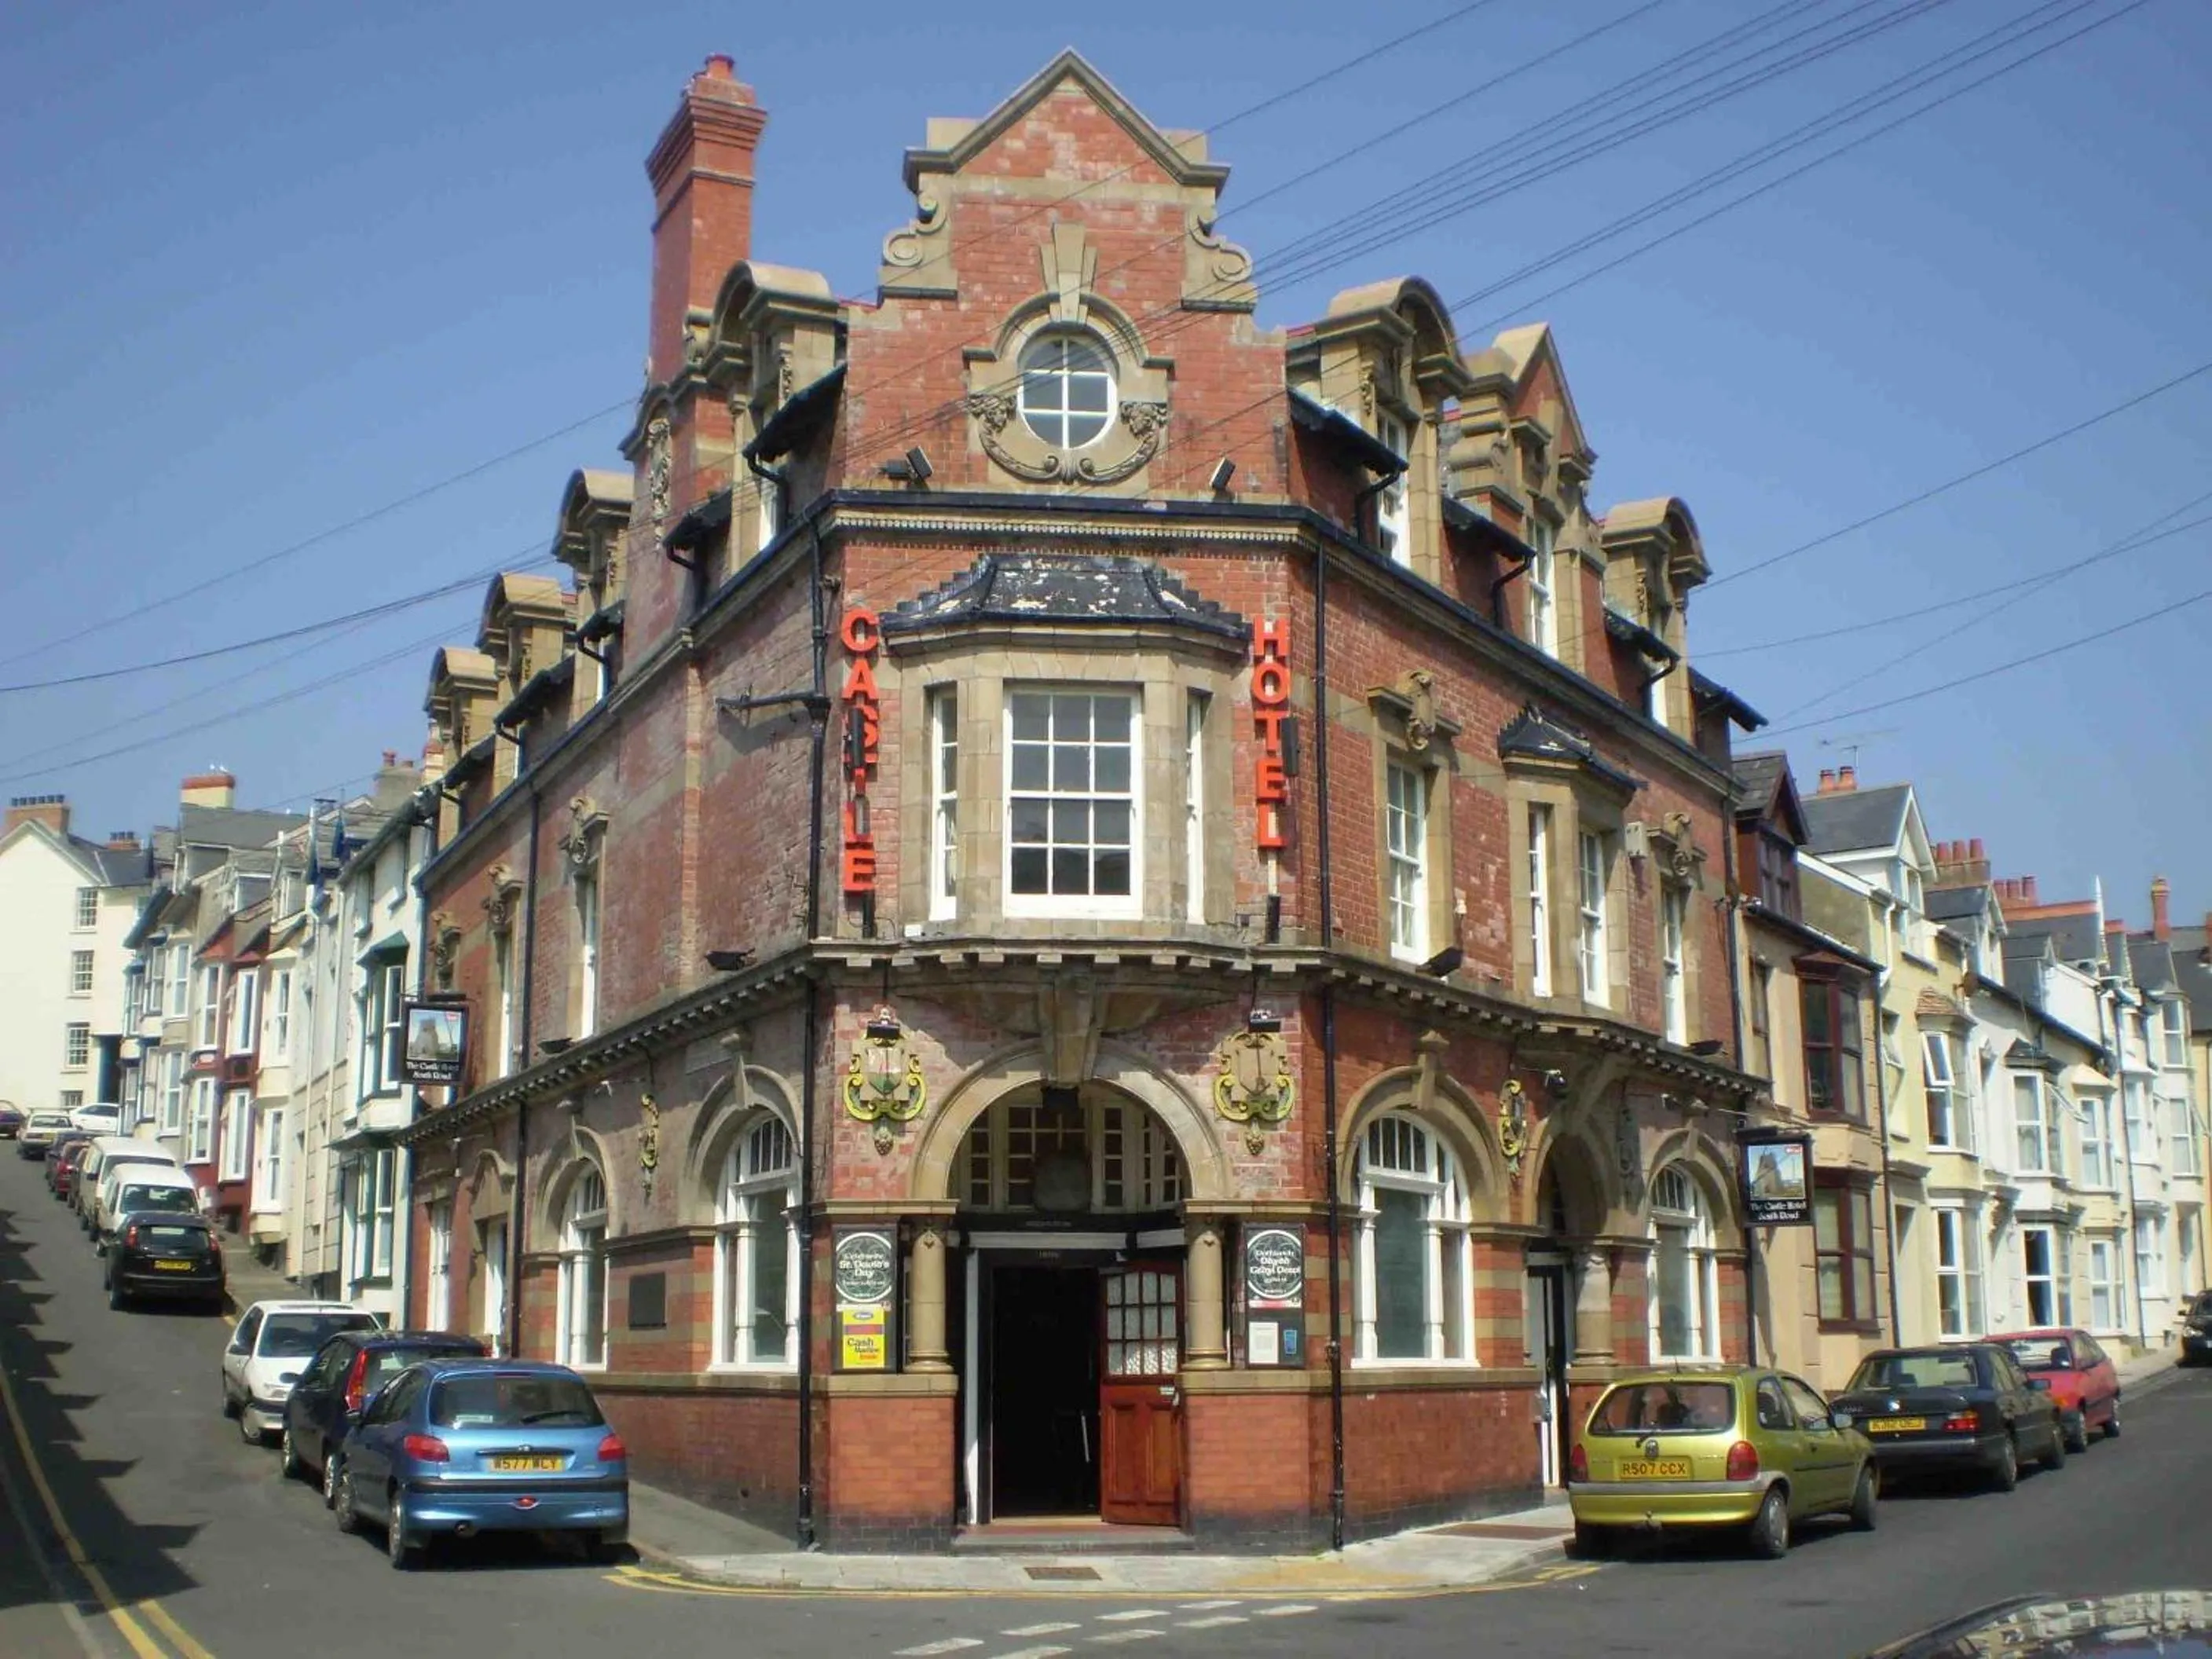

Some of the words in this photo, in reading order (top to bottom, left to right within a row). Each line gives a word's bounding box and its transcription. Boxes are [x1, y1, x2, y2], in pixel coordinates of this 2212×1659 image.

[1251, 615, 1290, 848] HOTEL
[855, 1269, 874, 1279] Day
[848, 1337, 873, 1346] Cash
[1623, 1463, 1657, 1474] R507
[1660, 1463, 1686, 1474] CCX
